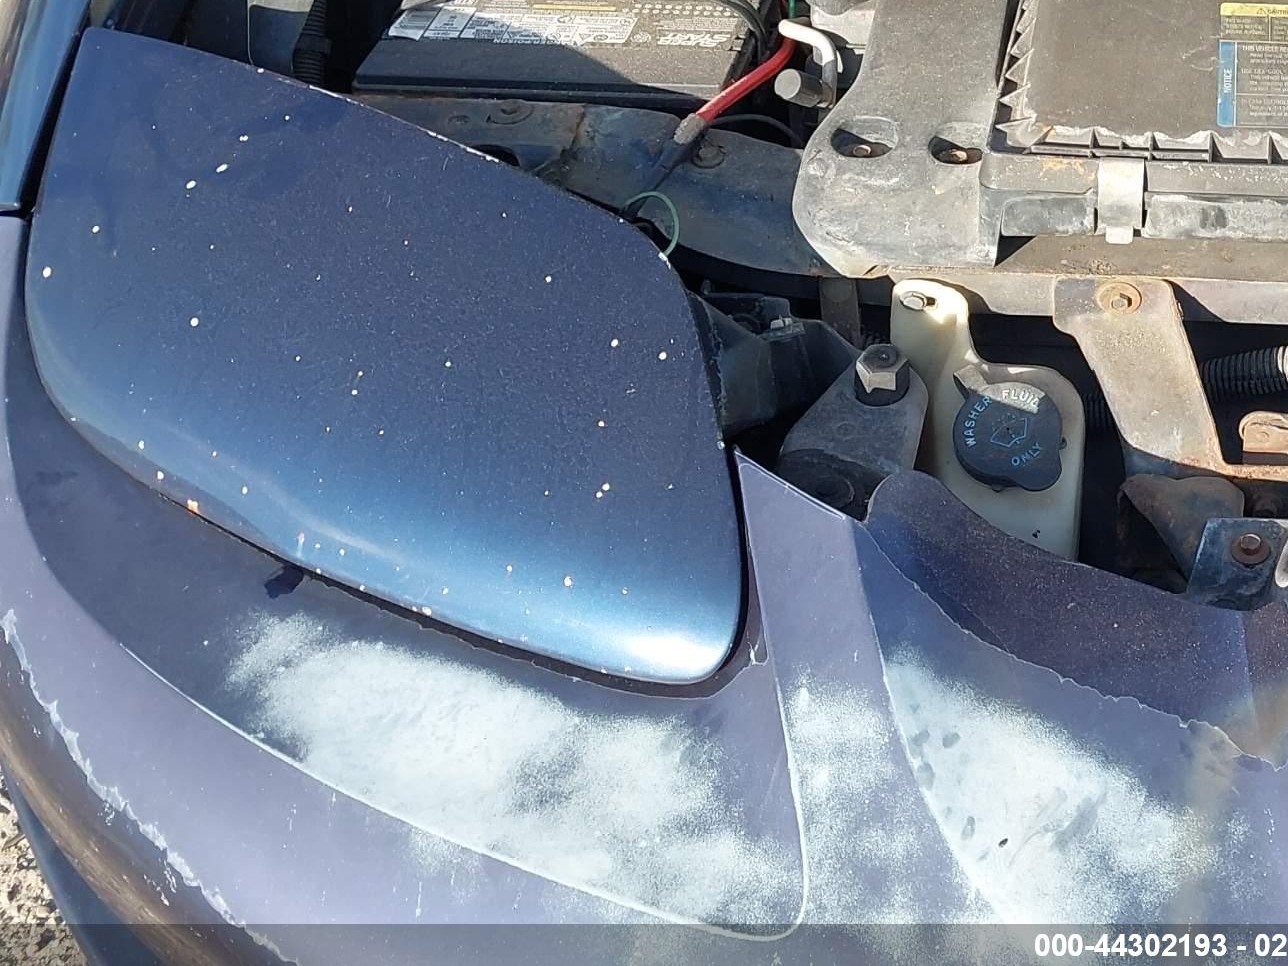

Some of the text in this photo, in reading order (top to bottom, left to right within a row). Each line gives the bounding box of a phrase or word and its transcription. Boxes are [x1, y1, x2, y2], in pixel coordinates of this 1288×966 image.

[666, 30, 731, 42] START
[1223, 68, 1233, 93] NOTICE
[1001, 388, 1040, 408] FLUID
[963, 395, 993, 448] WASHER
[1011, 442, 1044, 466] ONLY
